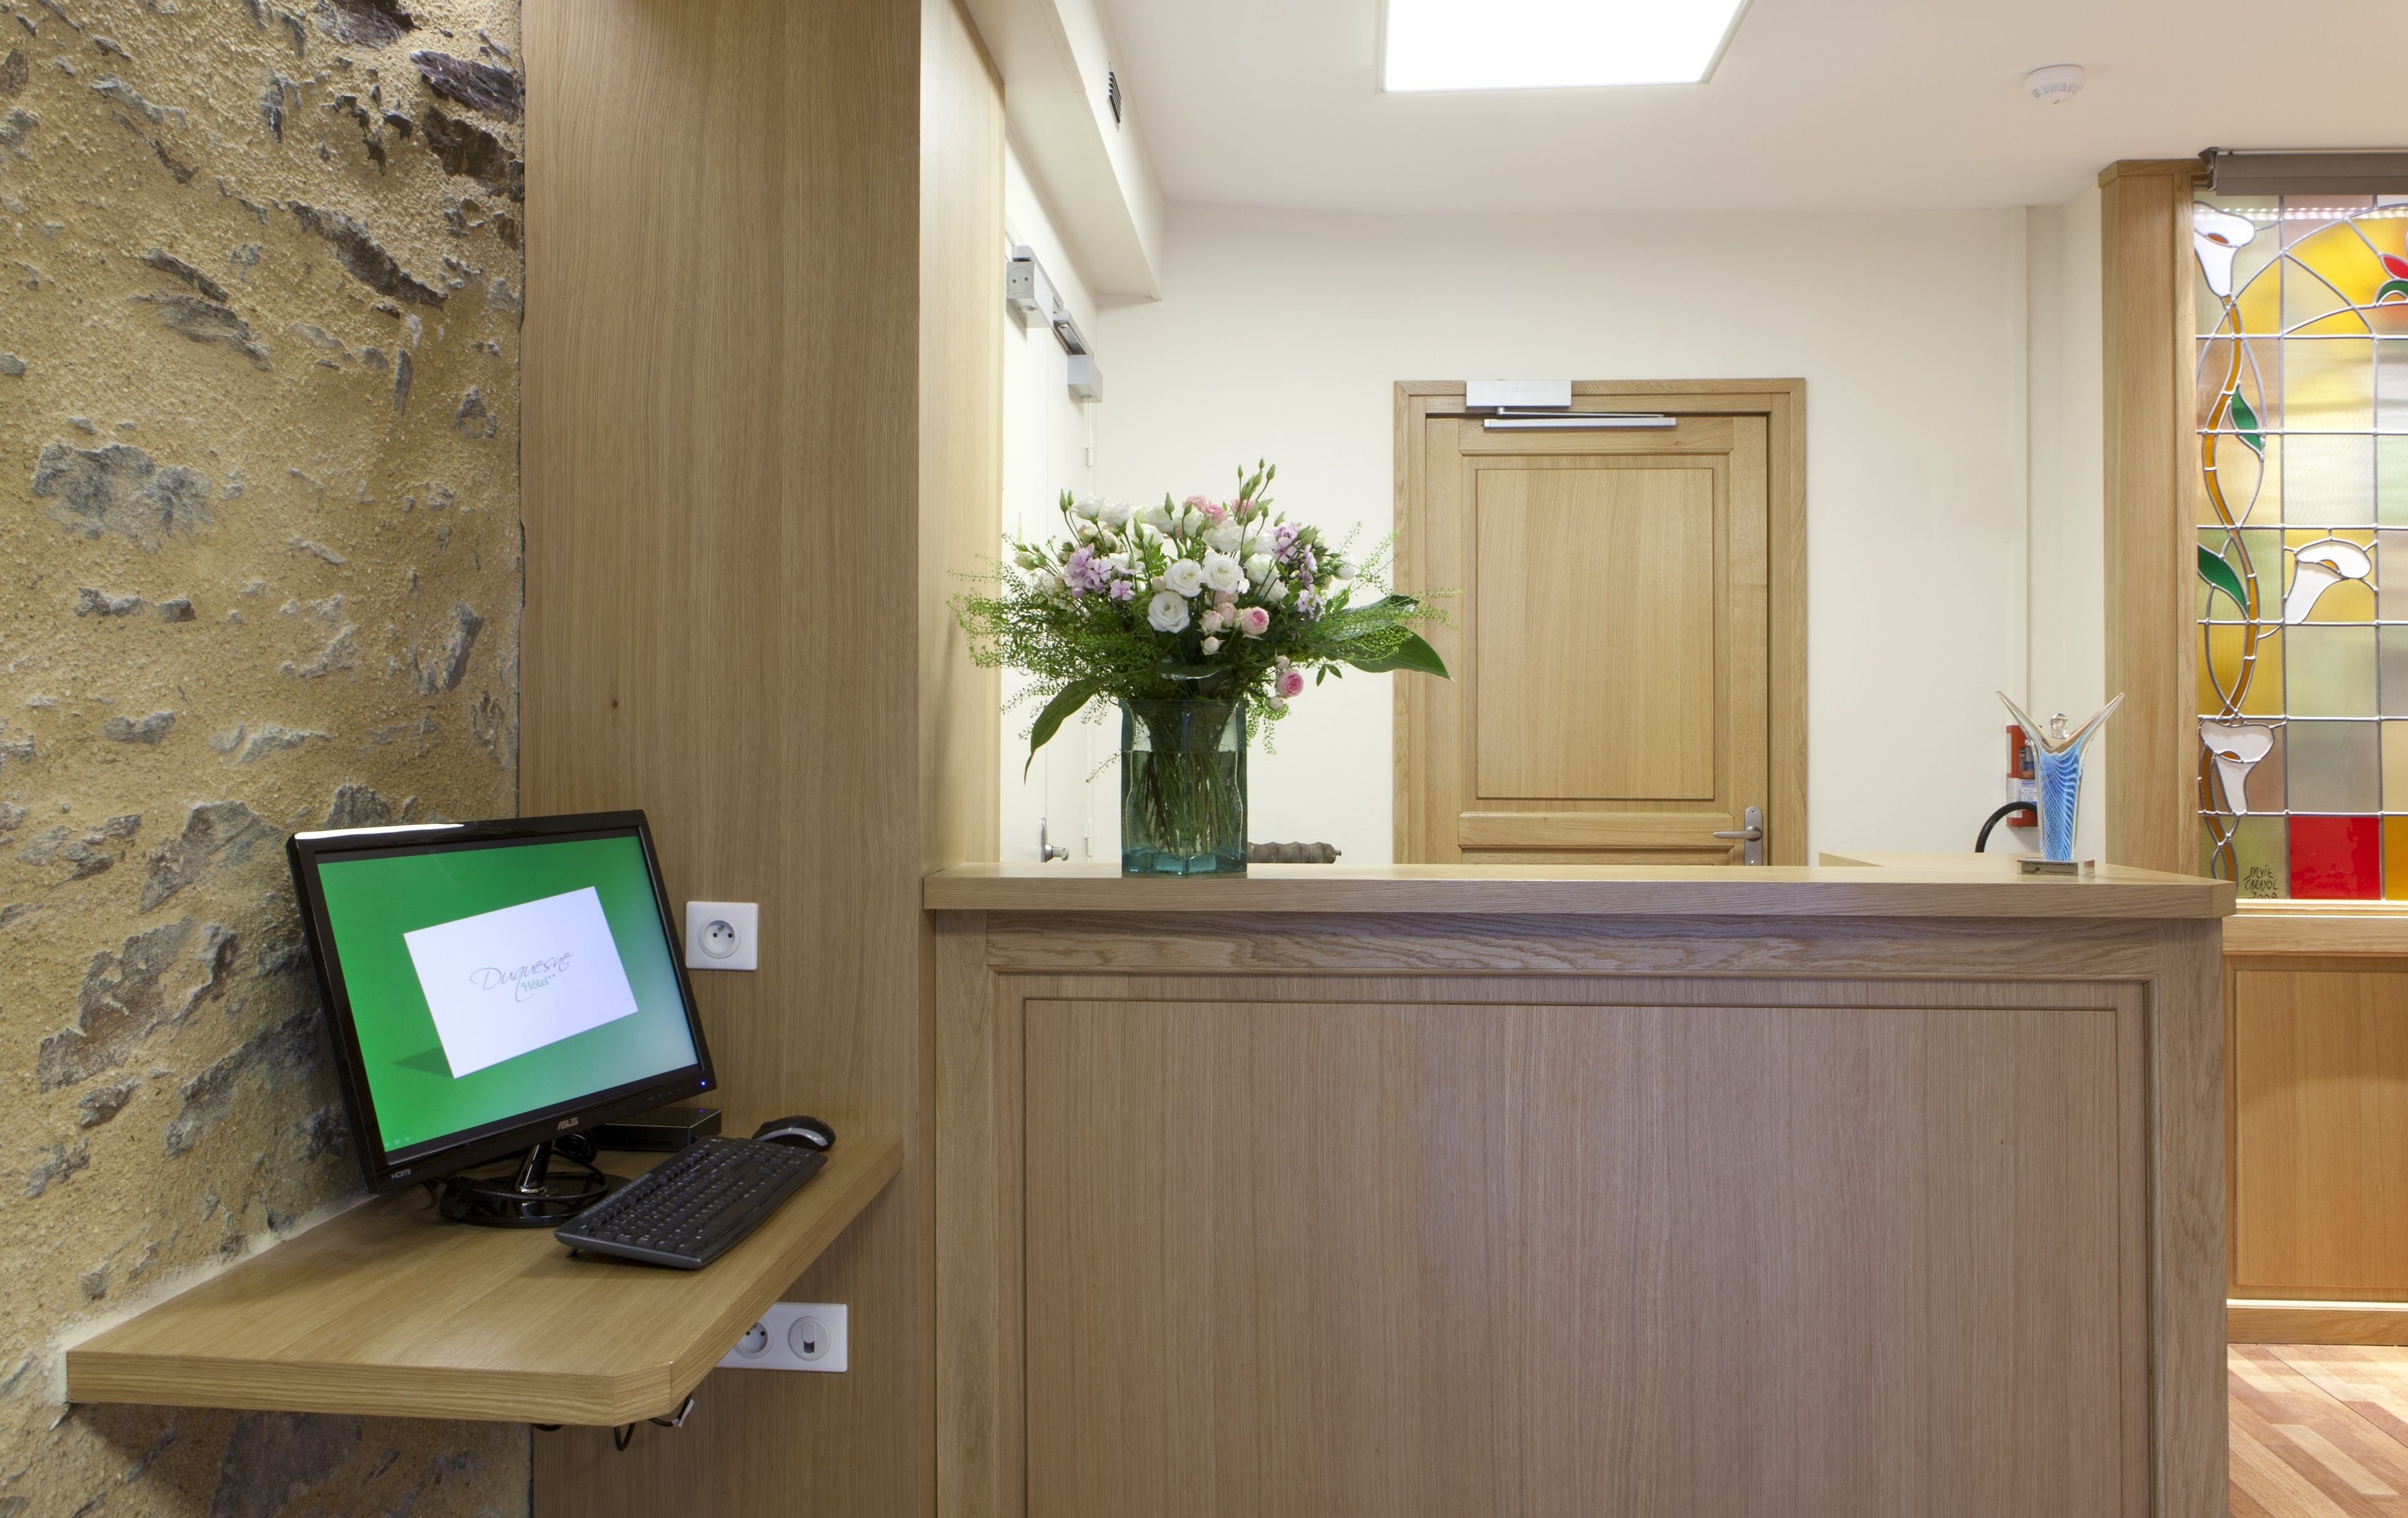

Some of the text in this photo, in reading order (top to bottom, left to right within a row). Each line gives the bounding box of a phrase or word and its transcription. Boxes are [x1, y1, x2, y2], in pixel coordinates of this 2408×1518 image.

[2245, 879, 2279, 893] CARAYOL
[470, 952, 573, 1002] Duquesne
[557, 1117, 578, 1131] ASUS
[391, 1168, 411, 1180] HDMI
